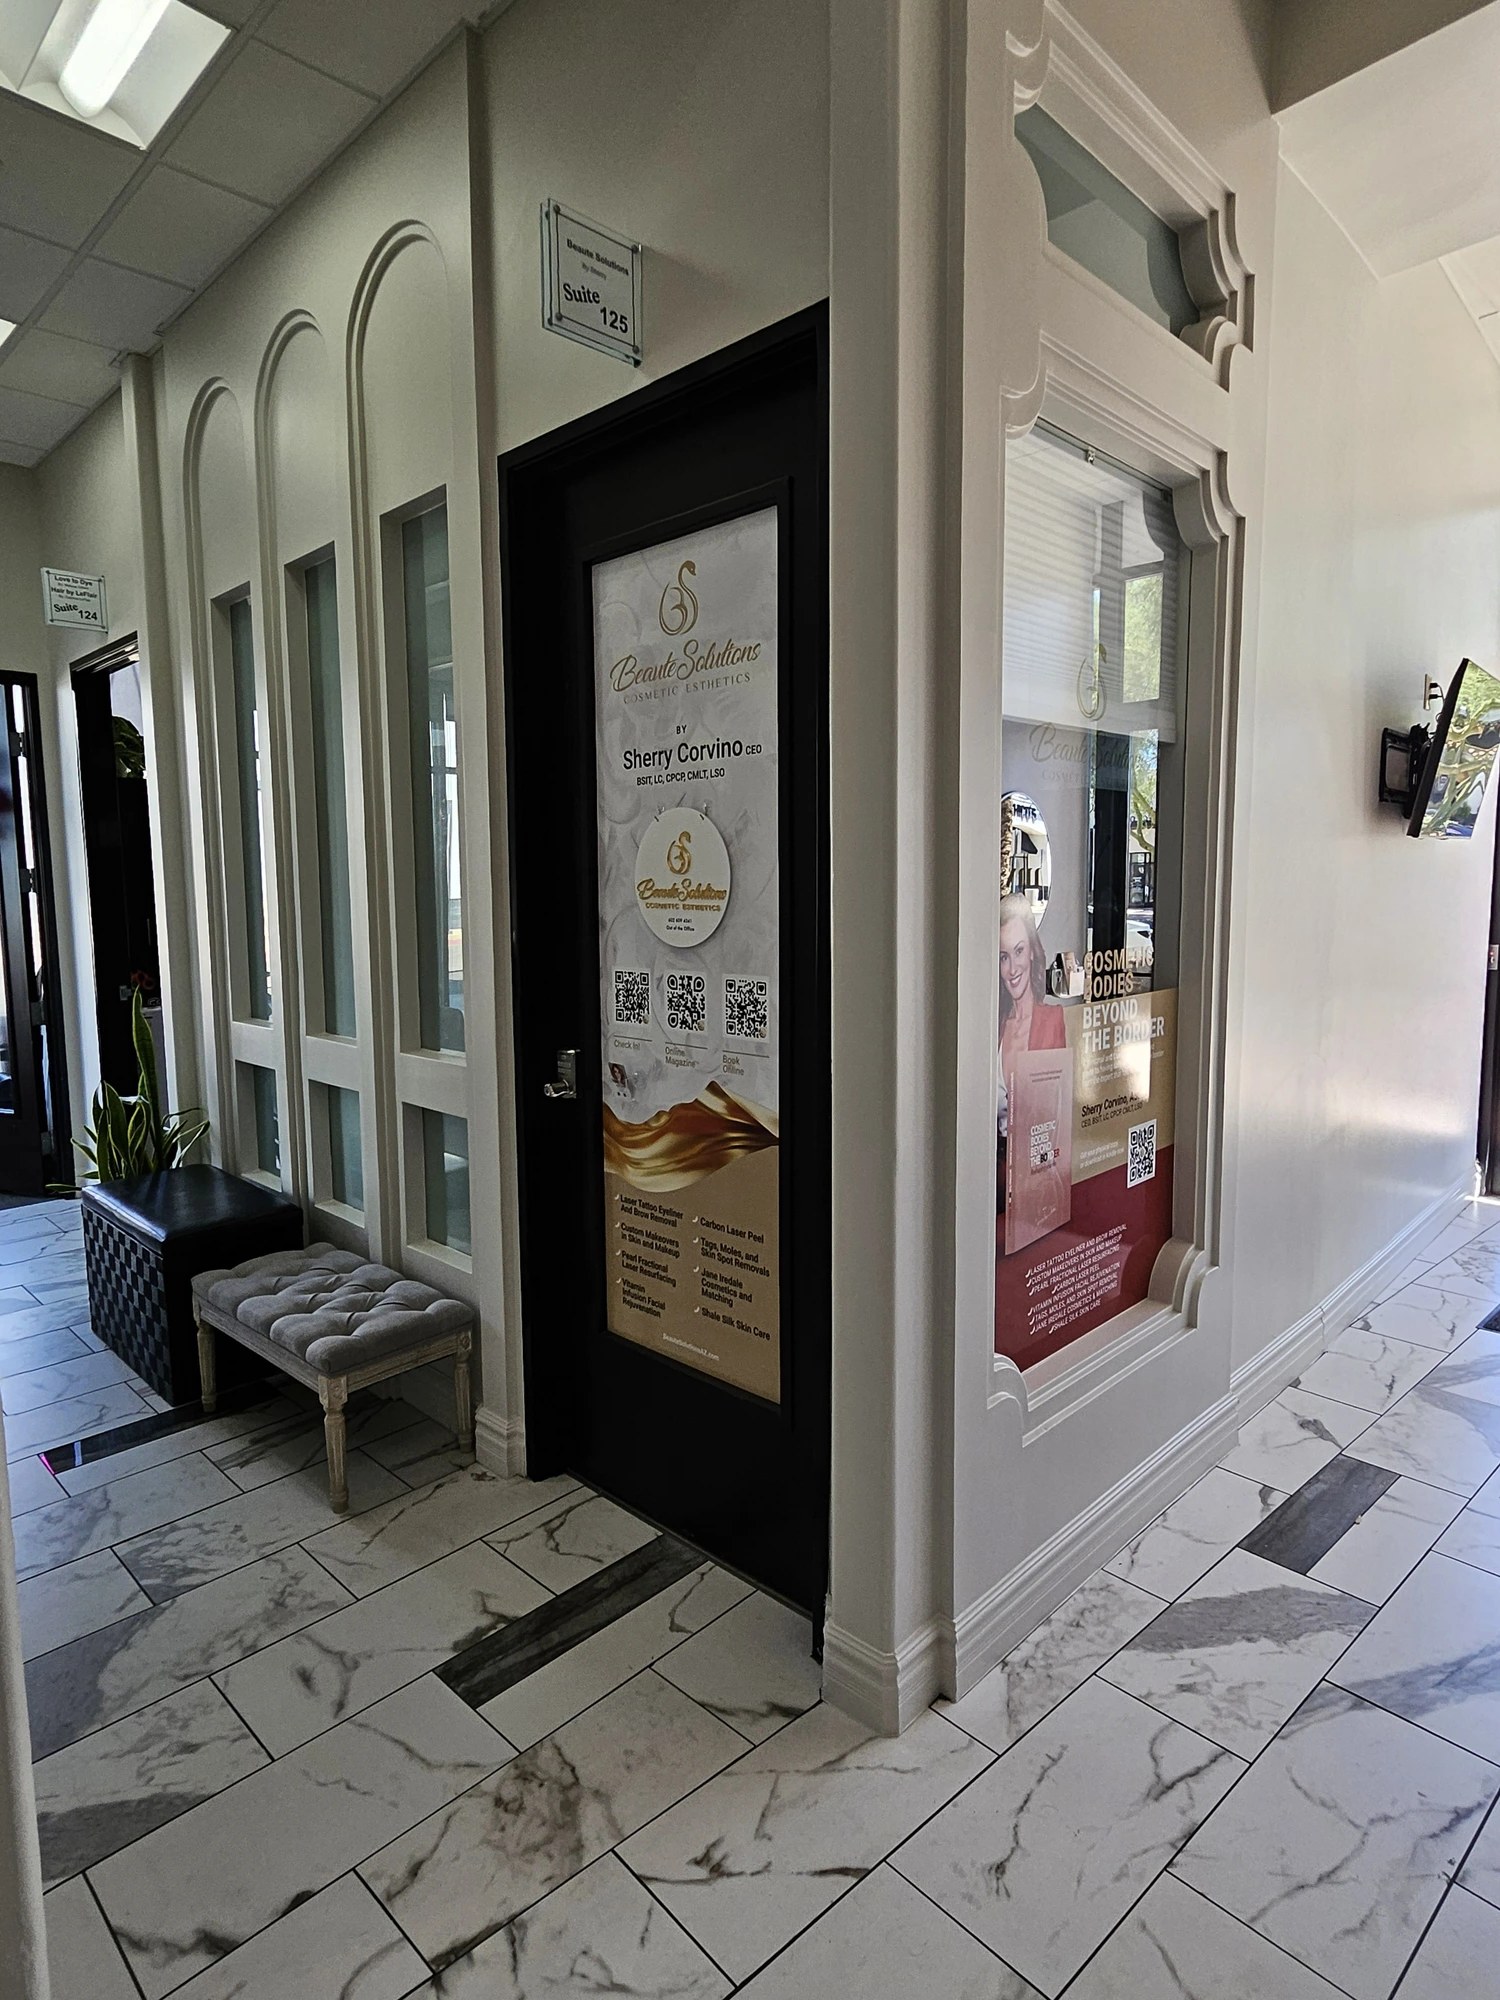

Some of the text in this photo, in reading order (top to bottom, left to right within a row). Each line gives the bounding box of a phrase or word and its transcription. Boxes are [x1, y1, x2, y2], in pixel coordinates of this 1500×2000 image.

[595, 252, 630, 276] Solutions
[563, 283, 600, 304] Suite
[600, 306, 628, 333] 125
[53, 603, 78, 612] Suite
[78, 610, 97, 620] 124
[677, 638, 761, 680] Solutions
[623, 672, 750, 704] COSMETIC ESTHETICS
[676, 725, 687, 734] BY
[623, 738, 762, 770] Sherry Corvino CEO
[637, 768, 725, 786] BSIT, LC, CPCP, CMLT, LSO
[682, 904, 721, 912] ESTHETICS
[1083, 999, 1137, 1029] BEYOND
[614, 1039, 632, 1050] Check
[1082, 1027, 1110, 1053] THE
[1114, 1016, 1164, 1047] BORDER
[665, 1046, 686, 1057] Online
[665, 1056, 697, 1068] Magazine
[722, 1055, 740, 1065] Book
[1082, 1103, 1102, 1117] Sherry
[1104, 1095, 1128, 1110] Corvino,
[1031, 1120, 1055, 1136] COSMETIC
[1031, 1132, 1049, 1146] BODIES
[1031, 1142, 1051, 1157] BEYOND
[621, 1194, 683, 1219] Laser Tattoo Eyeliner
[634, 1207, 649, 1219] Brow
[650, 1213, 677, 1227] Removal
[621, 1223, 679, 1247] Custom Makeovers
[701, 1217, 764, 1243] Carbon Laser Peel
[628, 1234, 641, 1245] Skin
[643, 1240, 653, 1249] and
[655, 1243, 680, 1258] Makeup
[701, 1237, 758, 1263] Tags, Moles, and
[1031, 1224, 1127, 1275] LASER TATTOO EYELINER AND BROW REMOVAL
[622, 1251, 668, 1272] Pearl Fractional
[701, 1247, 769, 1277] Skin Spot Removals
[1031, 1272, 1051, 1285] CUSTOM
[1052, 1256, 1079, 1274] MAKEOVERS
[1085, 1248, 1095, 1257] SKIN
[1096, 1243, 1105, 1252] AND
[1106, 1234, 1122, 1247] MAKEUP
[1034, 1244, 1119, 1293] PEARL FRACTIONAL LASER RESURFACING
[622, 1278, 645, 1292] Vitamin
[640, 1266, 676, 1287] Resurfacing
[702, 1268, 743, 1289] Jane Iredale
[1033, 1262, 1120, 1313] VITAMIN INFUSION FACIAL REJUVENATION
[1057, 1264, 1100, 1291] CARBON LASER PEEL
[1066, 1295, 1075, 1304] AND
[1077, 1289, 1086, 1299] SKIN
[1088, 1281, 1098, 1294] SPOT
[1099, 1272, 1118, 1286] REMOVAL
[702, 1278, 752, 1303] Cosmetics and
[702, 1287, 733, 1308] Matching
[648, 1297, 665, 1310] Facial
[1035, 1321, 1047, 1332] JANE
[1048, 1309, 1066, 1323] IREDALE
[1067, 1295, 1091, 1312] COSMETICS
[1096, 1280, 1117, 1296] MATCHING
[1054, 1298, 1100, 1331] SHALE SILK SKIN CARE
[702, 1308, 770, 1340] Shale Silk Skin Care
